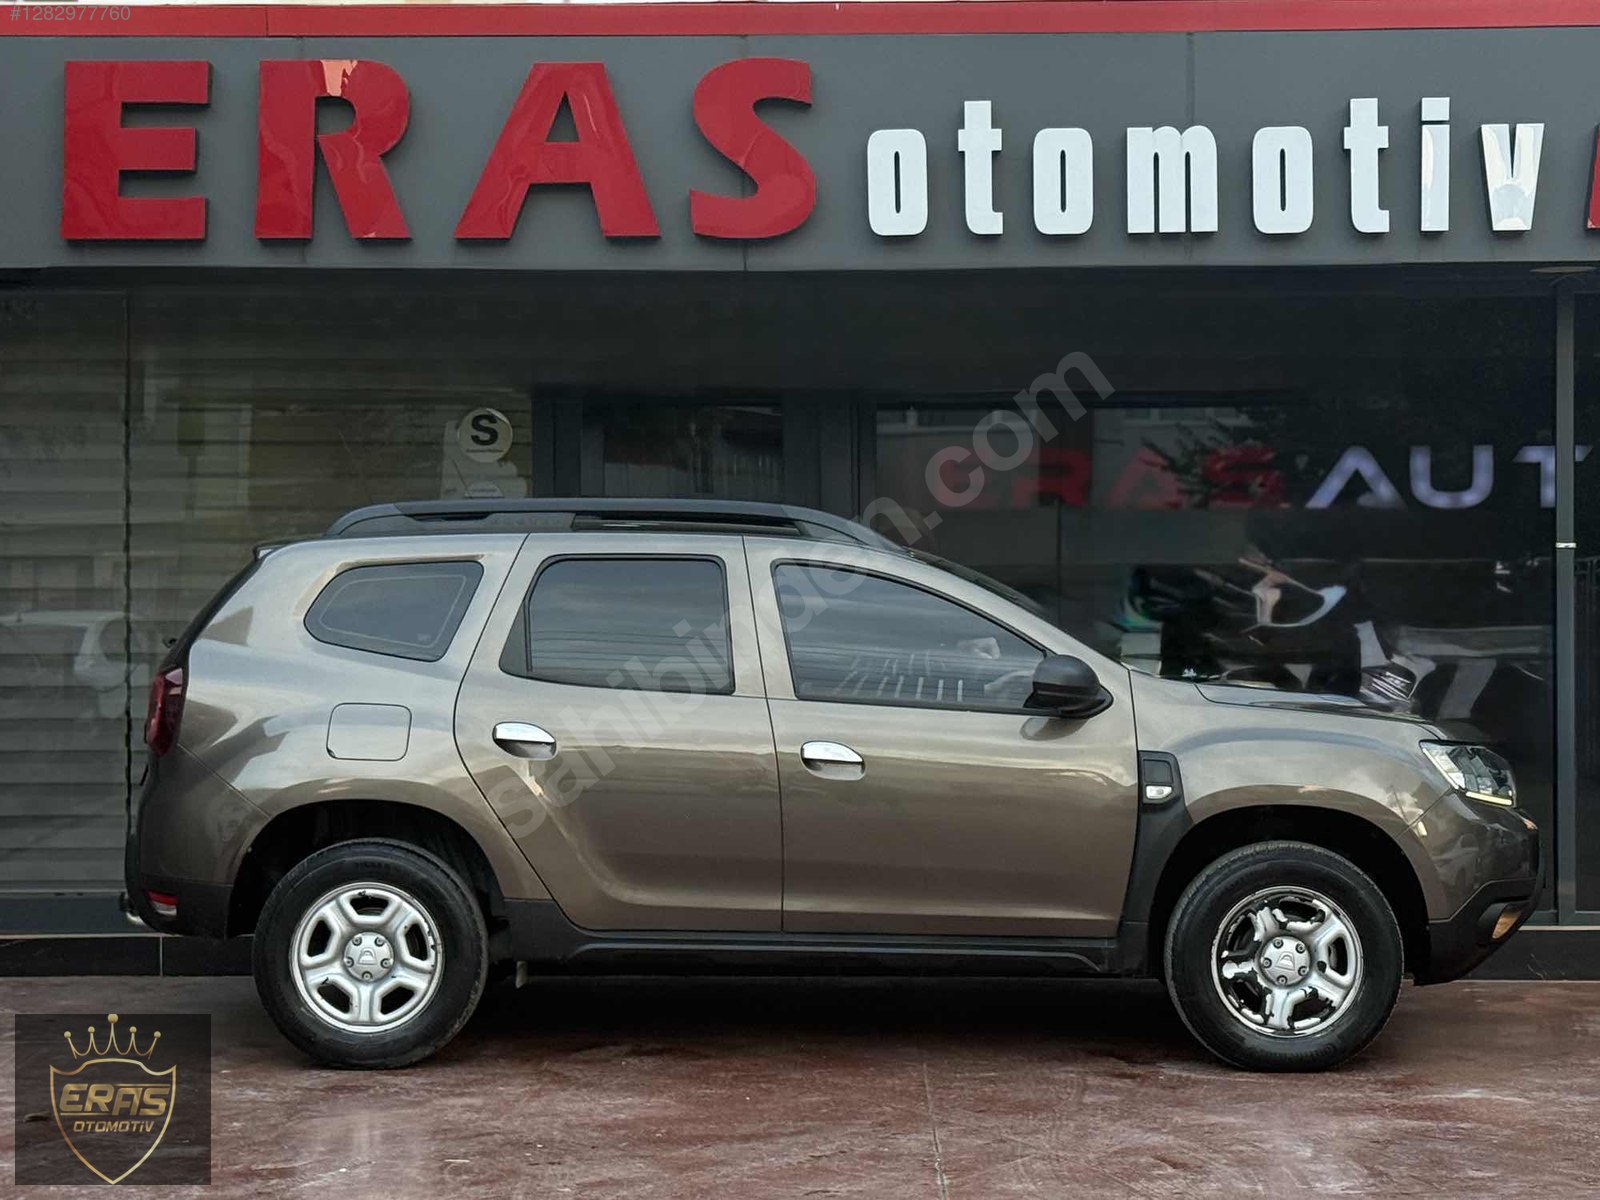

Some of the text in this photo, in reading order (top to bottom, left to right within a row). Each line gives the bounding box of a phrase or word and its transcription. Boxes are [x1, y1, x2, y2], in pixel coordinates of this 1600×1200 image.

[61, 57, 817, 241] ERAS
[866, 96, 1545, 237] otomotiv
[470, 414, 498, 446] S
